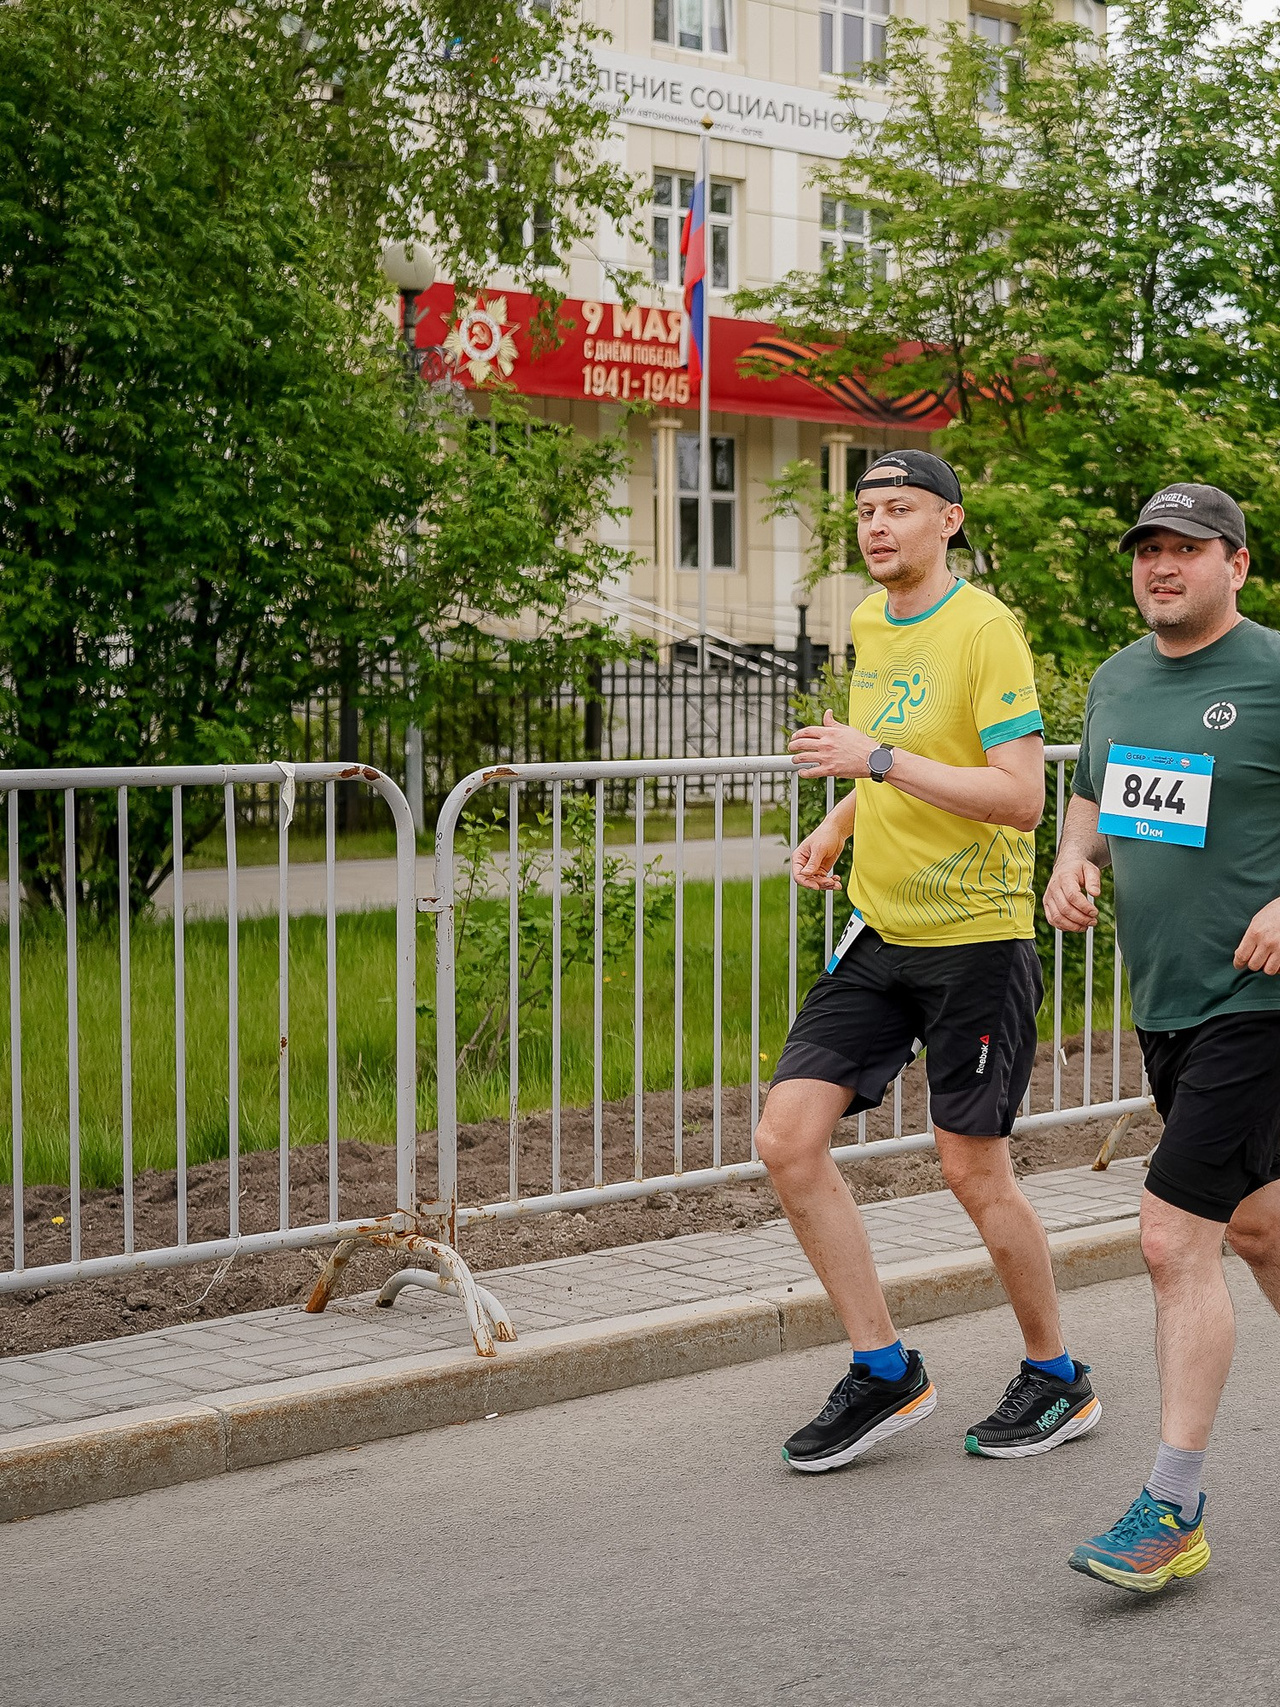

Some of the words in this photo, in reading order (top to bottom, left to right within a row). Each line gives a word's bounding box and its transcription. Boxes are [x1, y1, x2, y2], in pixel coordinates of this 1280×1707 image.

[581, 301, 603, 336] 9
[612, 304, 682, 344] МАЯ
[583, 338, 595, 360] С
[594, 338, 633, 364] ДНЁМ
[582, 363, 690, 404] 1941-1945
[1122, 773, 1186, 815] 844
[975, 1044, 989, 1074] Reebok
